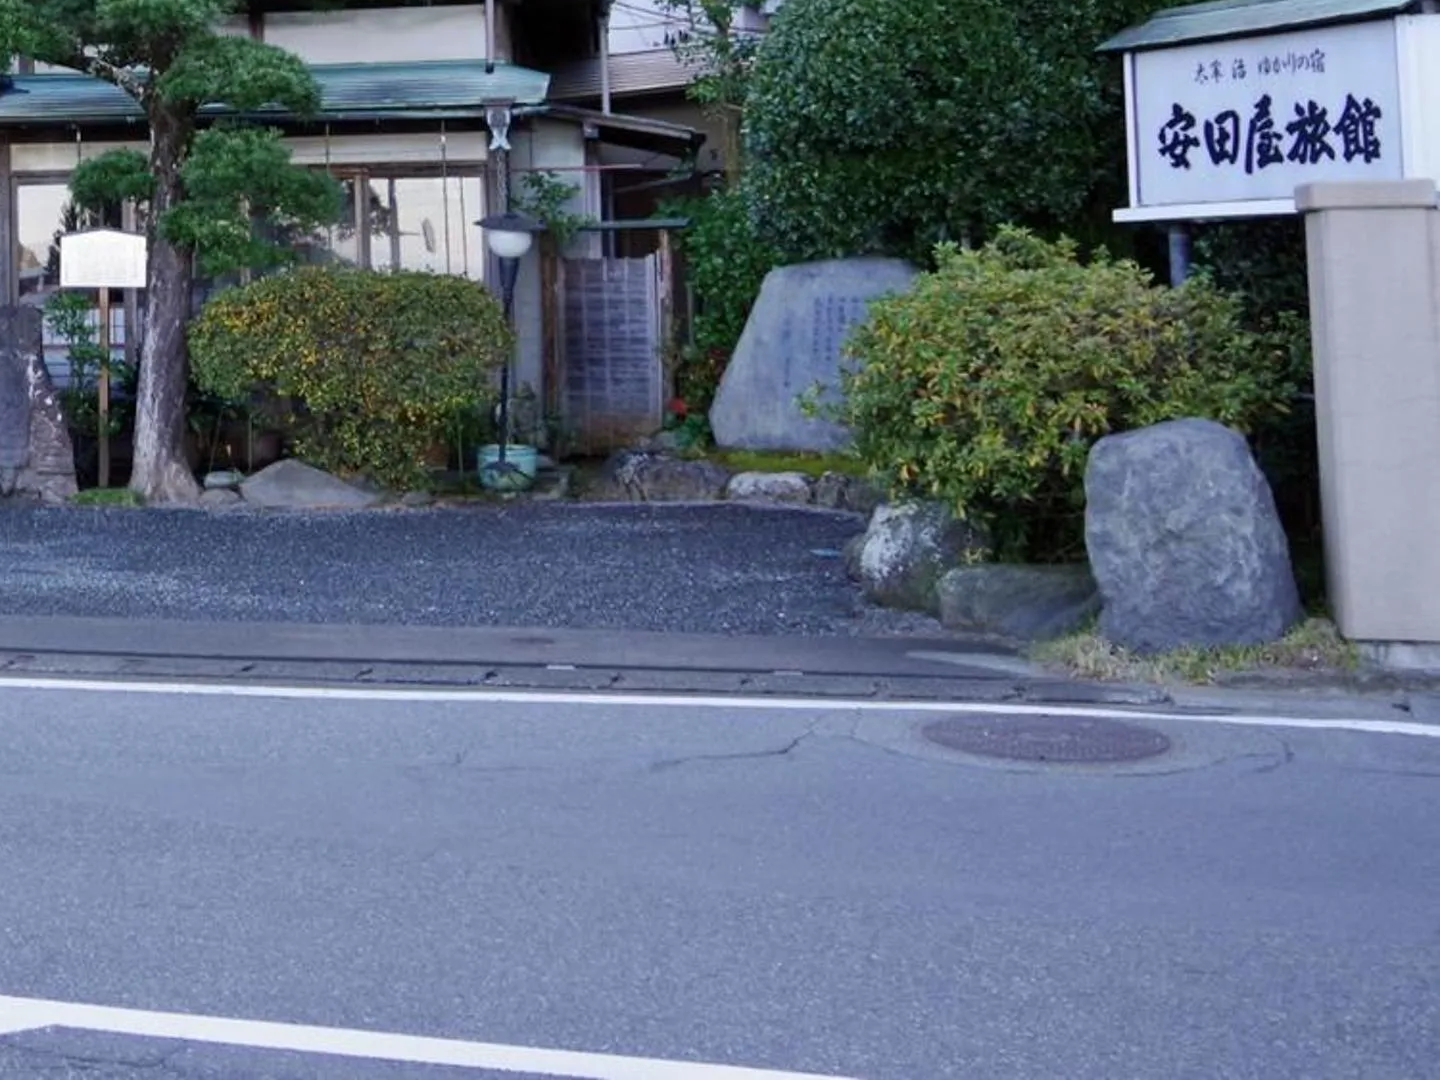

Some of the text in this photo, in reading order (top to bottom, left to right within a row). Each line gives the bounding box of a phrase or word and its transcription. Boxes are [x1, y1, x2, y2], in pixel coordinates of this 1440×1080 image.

[1158, 93, 1382, 174] 安田屋旅館
